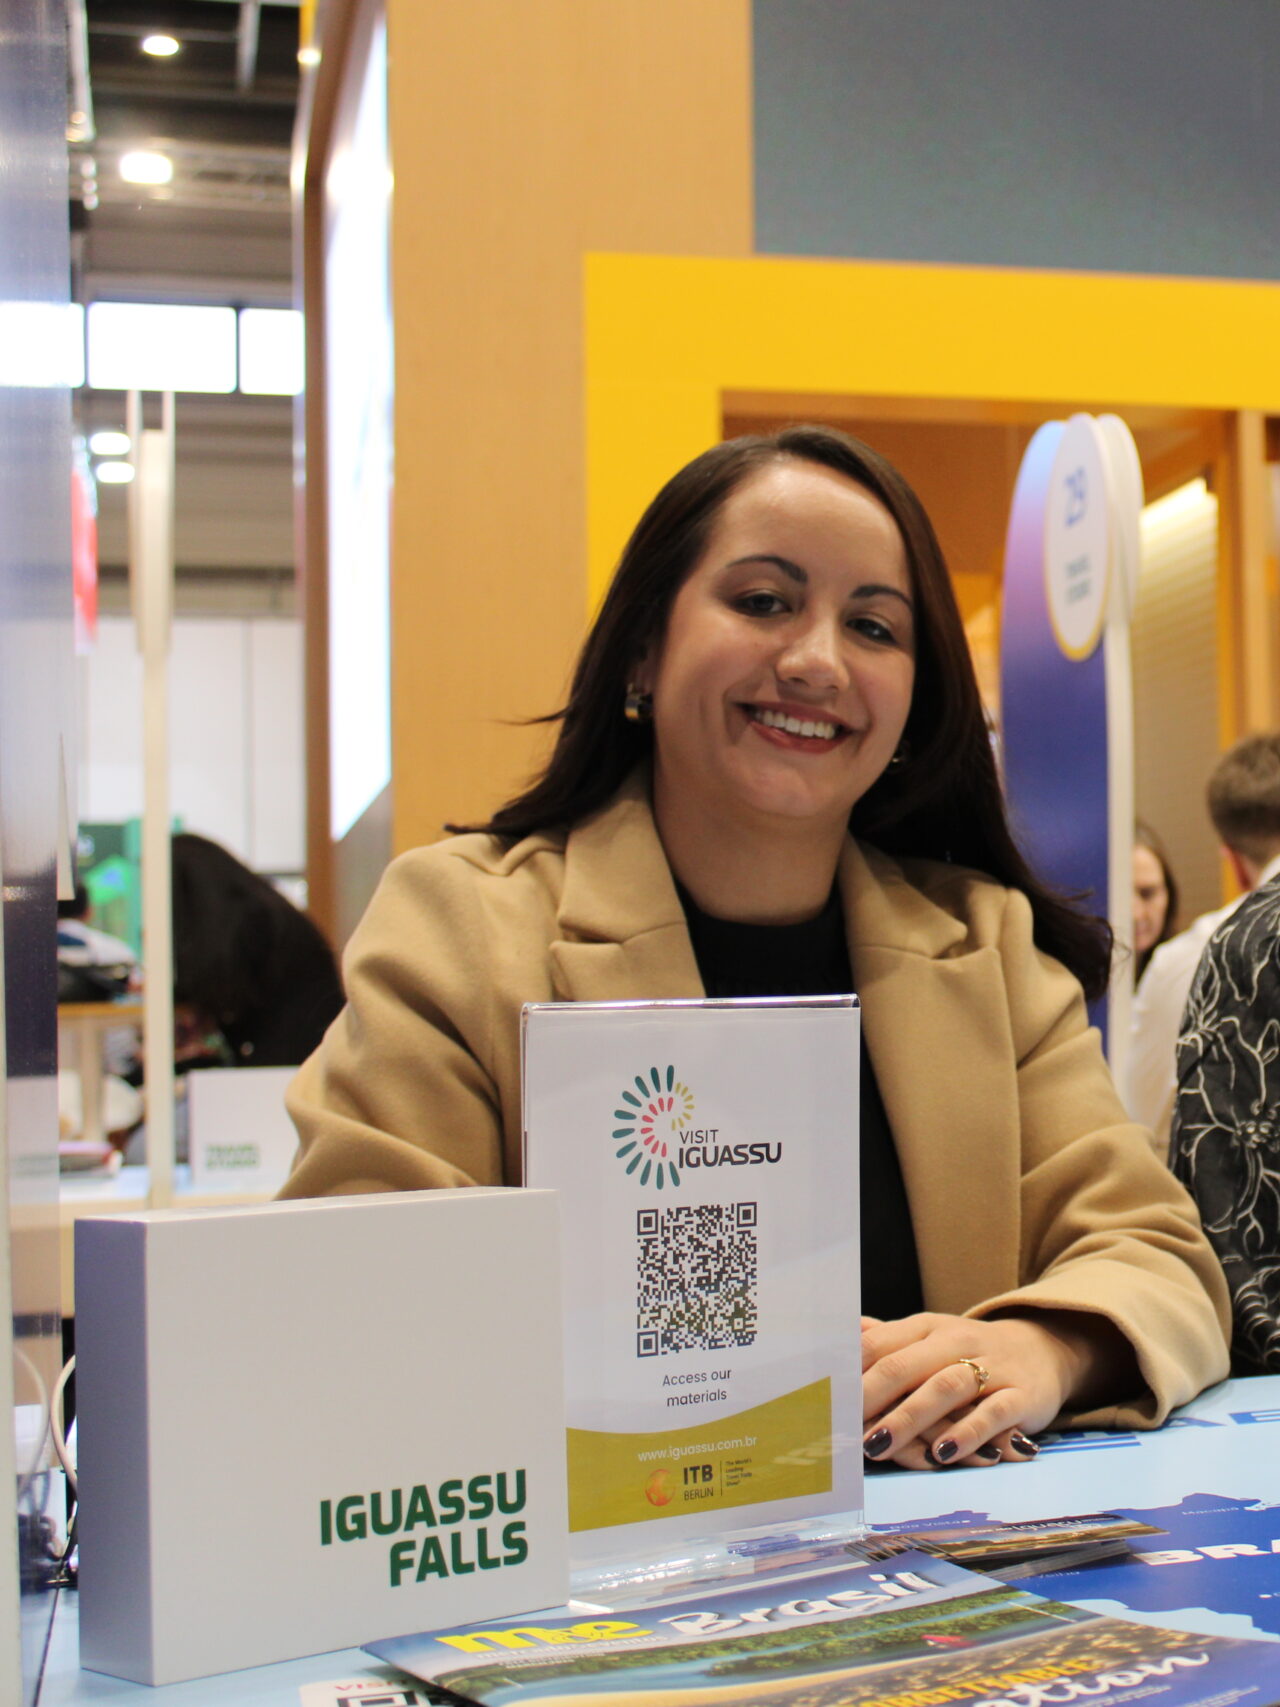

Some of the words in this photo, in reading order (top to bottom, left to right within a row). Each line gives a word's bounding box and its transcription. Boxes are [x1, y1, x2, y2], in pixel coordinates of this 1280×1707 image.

[679, 1129, 719, 1145] VISIT
[678, 1142, 782, 1169] IGUASSU
[662, 1372, 707, 1387] Access
[711, 1369, 732, 1381] our
[667, 1388, 728, 1407] materials
[637, 1436, 758, 1462] www.iguassu.com.br
[683, 1464, 714, 1485] ITB
[684, 1487, 714, 1501] BERLIN
[320, 1469, 527, 1546] IGUASSU
[390, 1521, 529, 1587] FALLS
[658, 1571, 944, 1636] Brasil
